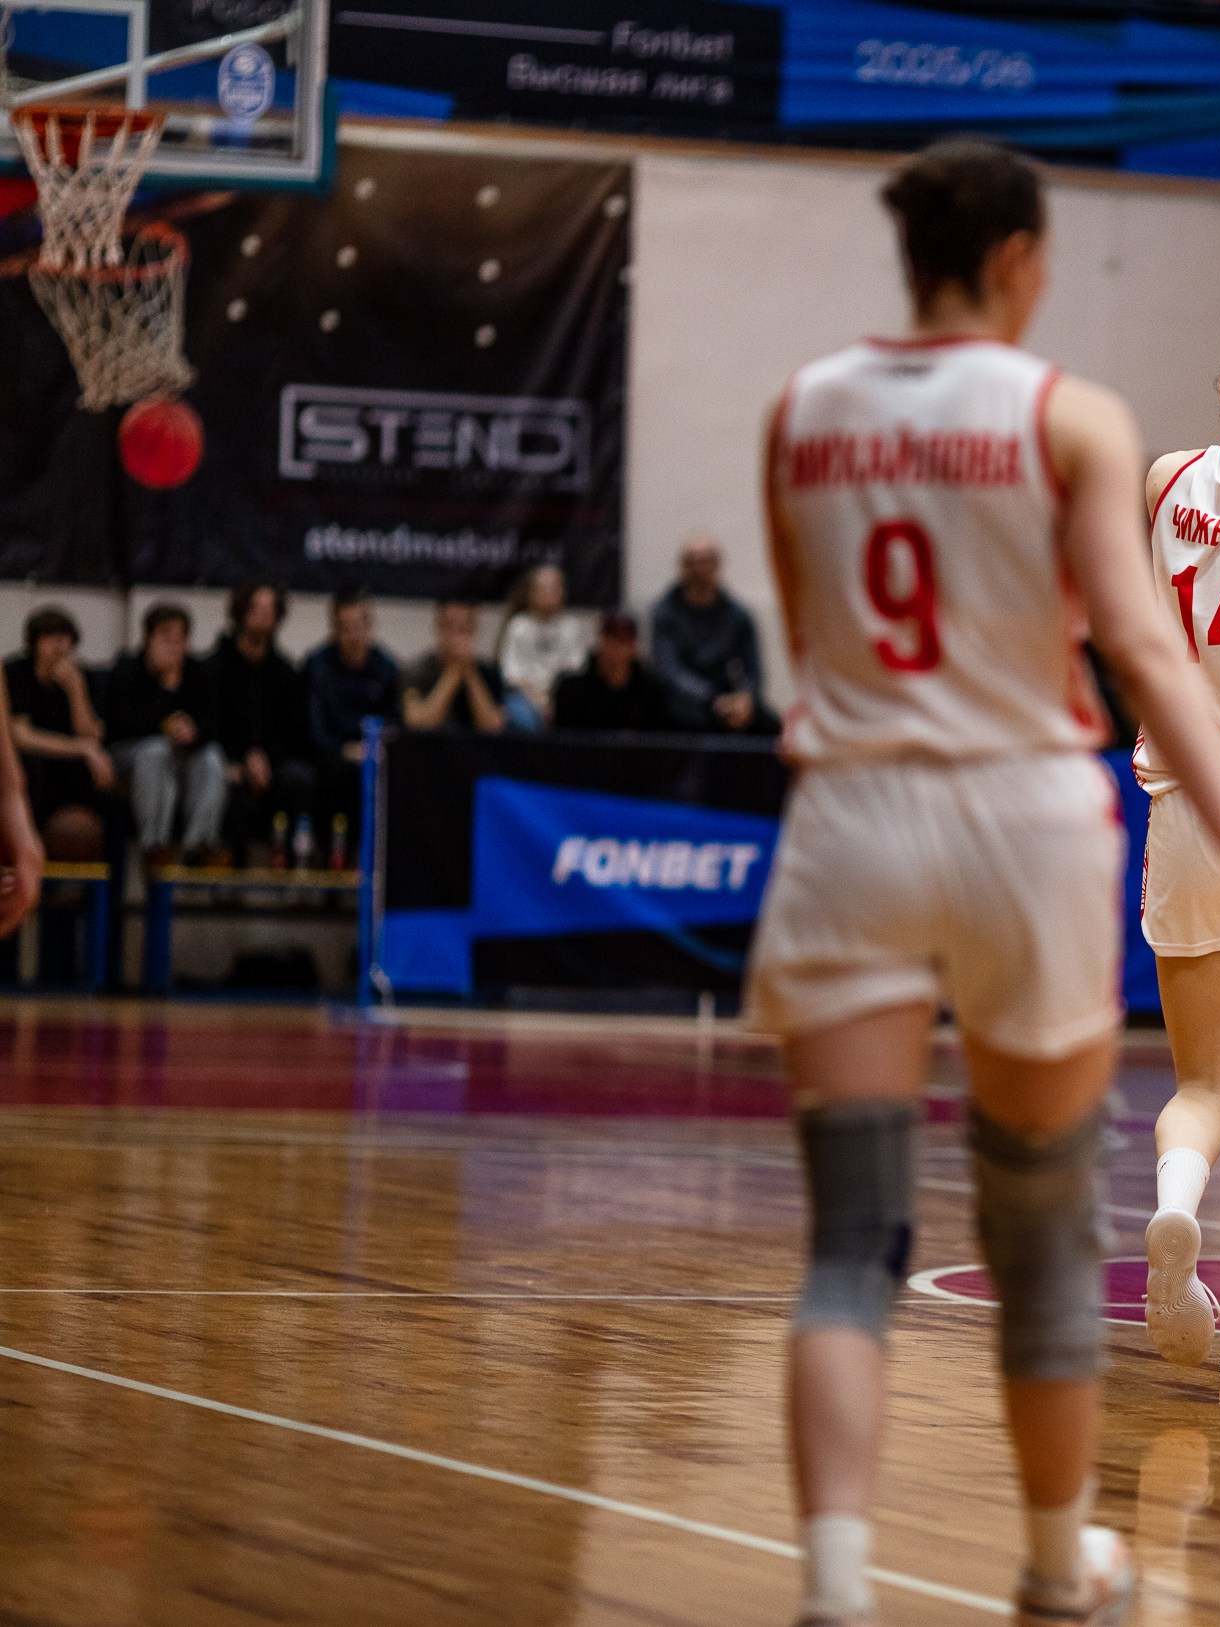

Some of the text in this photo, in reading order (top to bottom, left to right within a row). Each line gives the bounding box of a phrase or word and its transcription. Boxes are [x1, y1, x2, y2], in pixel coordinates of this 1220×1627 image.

[299, 405, 573, 473] STEND
[865, 519, 942, 675] 9
[552, 837, 760, 890] FONBET
